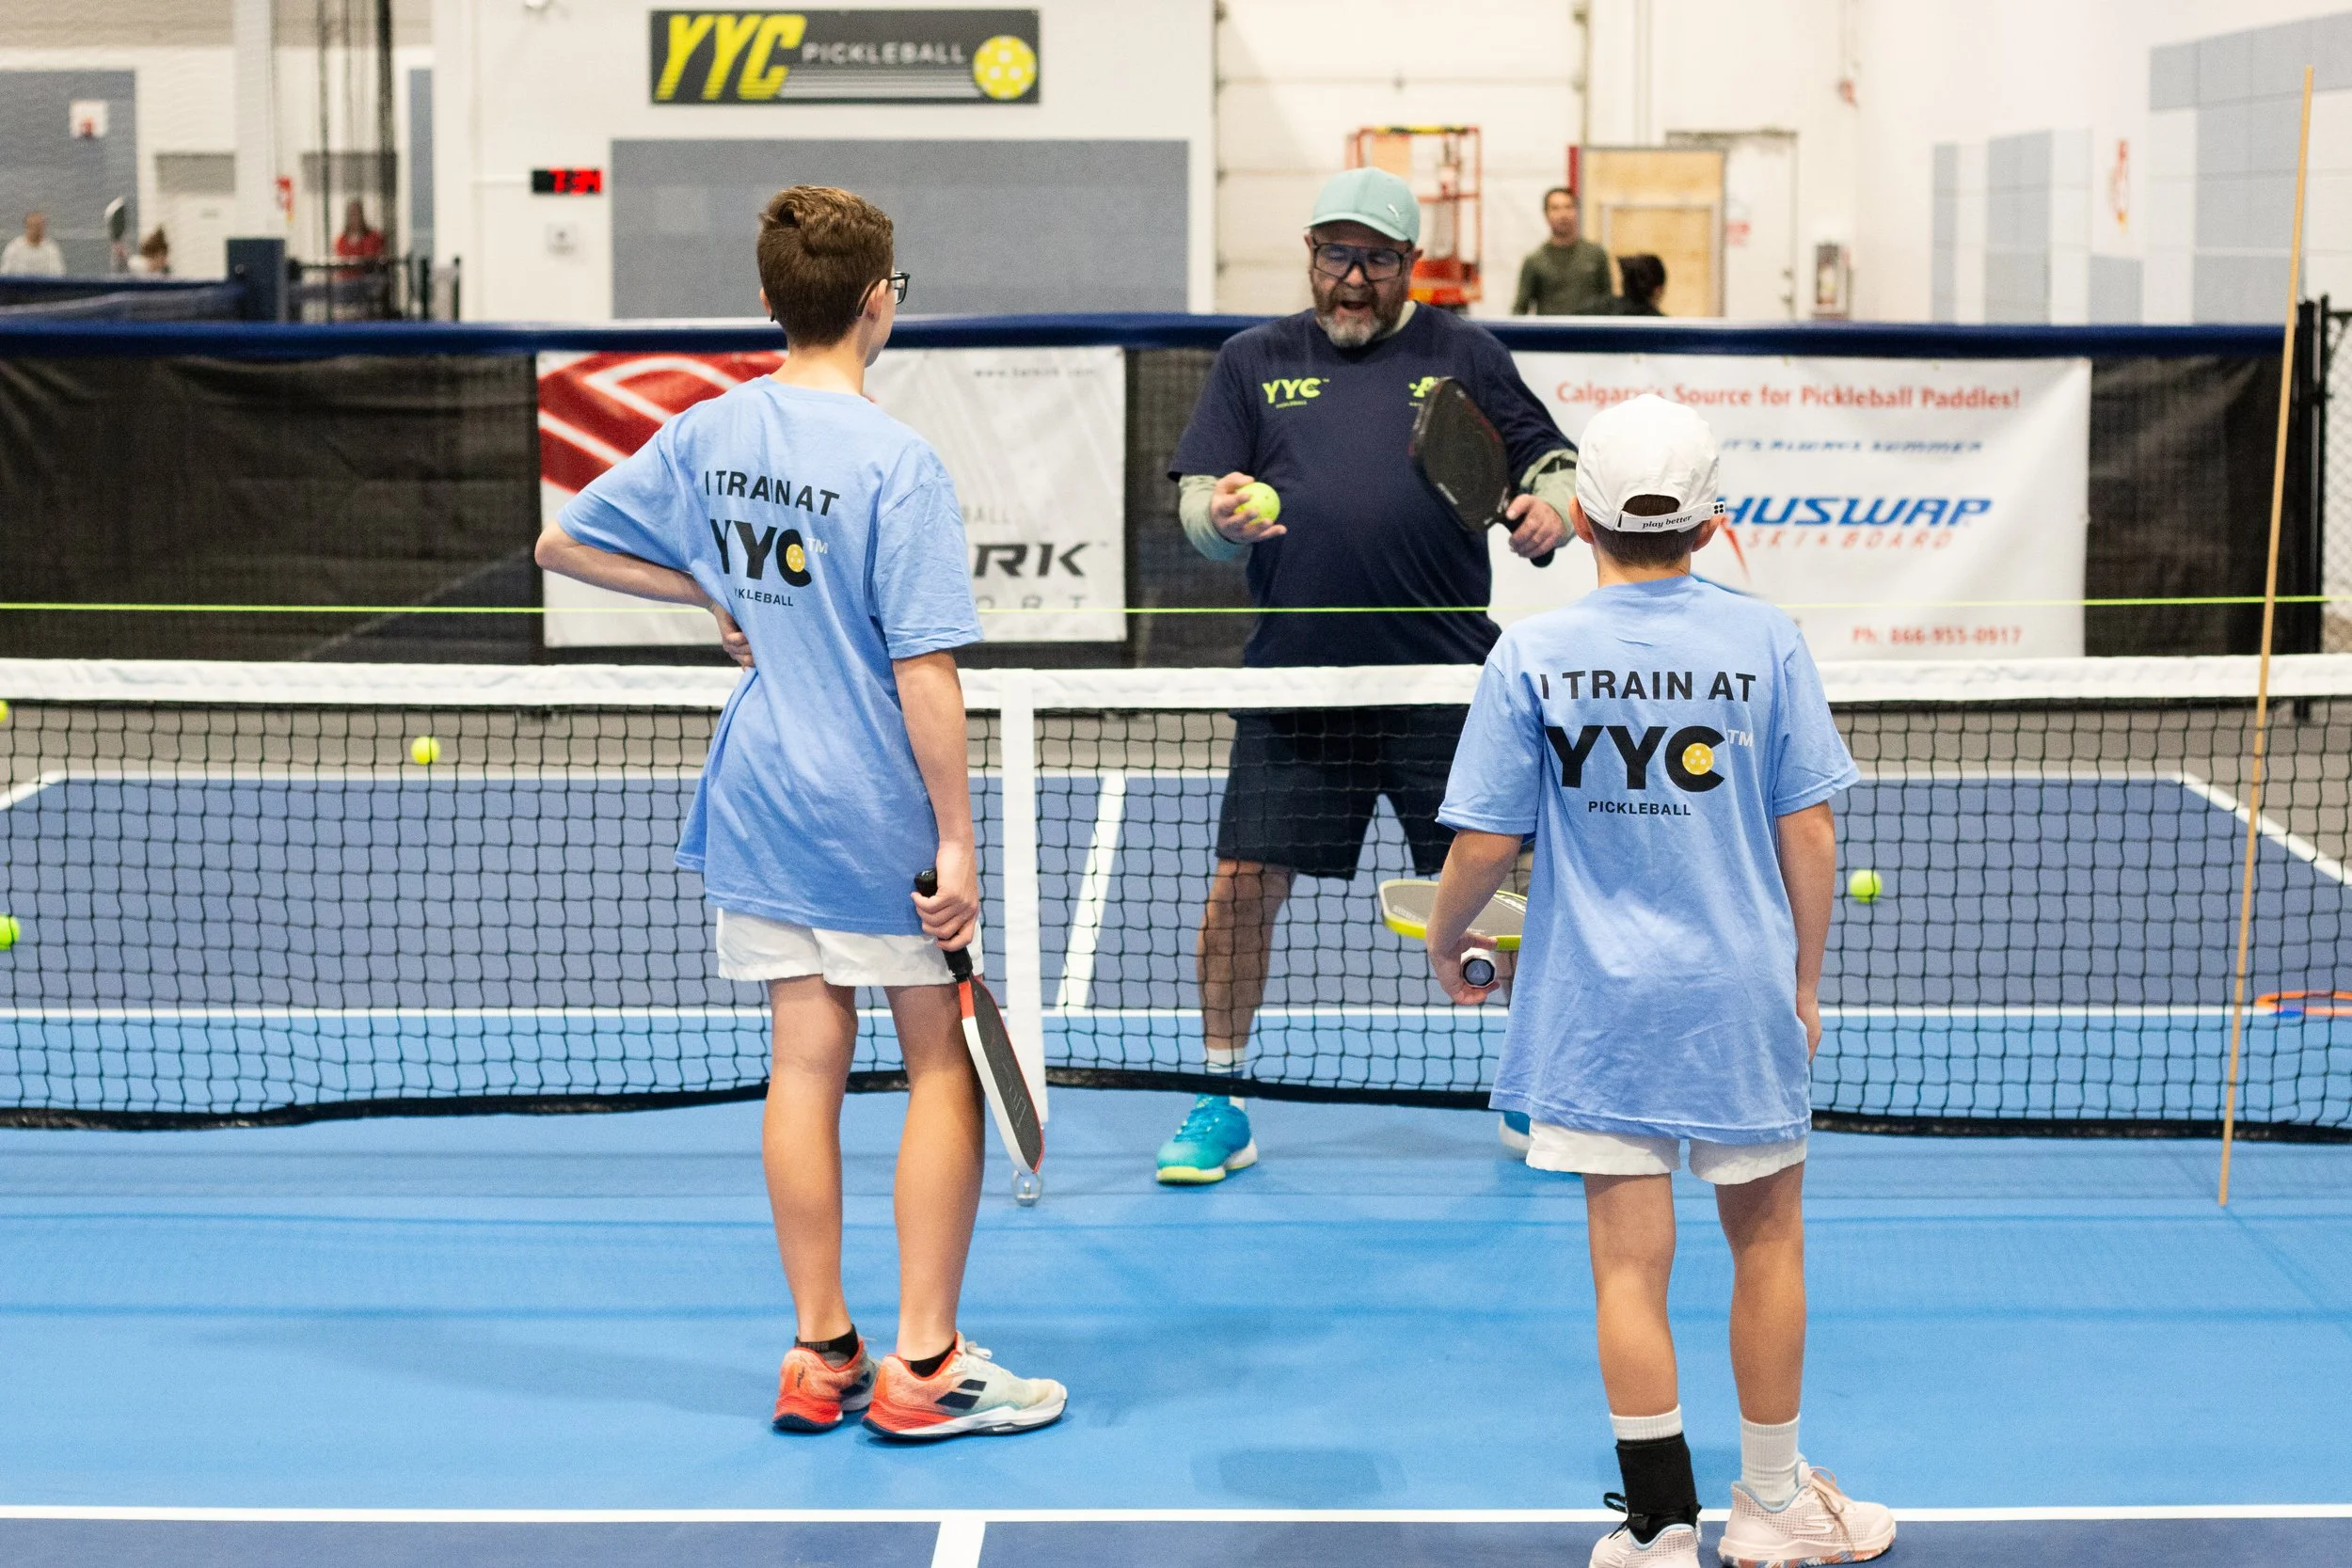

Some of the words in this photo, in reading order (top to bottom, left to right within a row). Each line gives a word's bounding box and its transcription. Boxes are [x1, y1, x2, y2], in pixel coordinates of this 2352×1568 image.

[655, 13, 807, 101] YYC
[802, 41, 965, 64] PICKLEBALL
[1262, 377, 1322, 404] YYC
[1556, 382, 1664, 406] Calgar's
[1674, 384, 1752, 405] Source
[1760, 385, 1792, 405] for
[1801, 386, 1914, 406] Pickleball
[1921, 388, 2021, 409] Paddles!
[706, 471, 710, 496] I
[795, 485, 840, 516] AT
[962, 504, 1009, 525] BALL
[1665, 515, 1692, 526] better
[1715, 497, 1993, 527] HUSWAP
[709, 518, 813, 588] YYC
[973, 543, 1089, 578] RK
[734, 587, 794, 607] KLEBALL
[976, 594, 1087, 612] ORT
[1539, 673, 1549, 700] I
[1562, 670, 1692, 700] TRAIN
[1708, 671, 1756, 703] AT
[1544, 724, 1725, 793] YYC
[1588, 800, 1692, 816] PICKLEBALL
